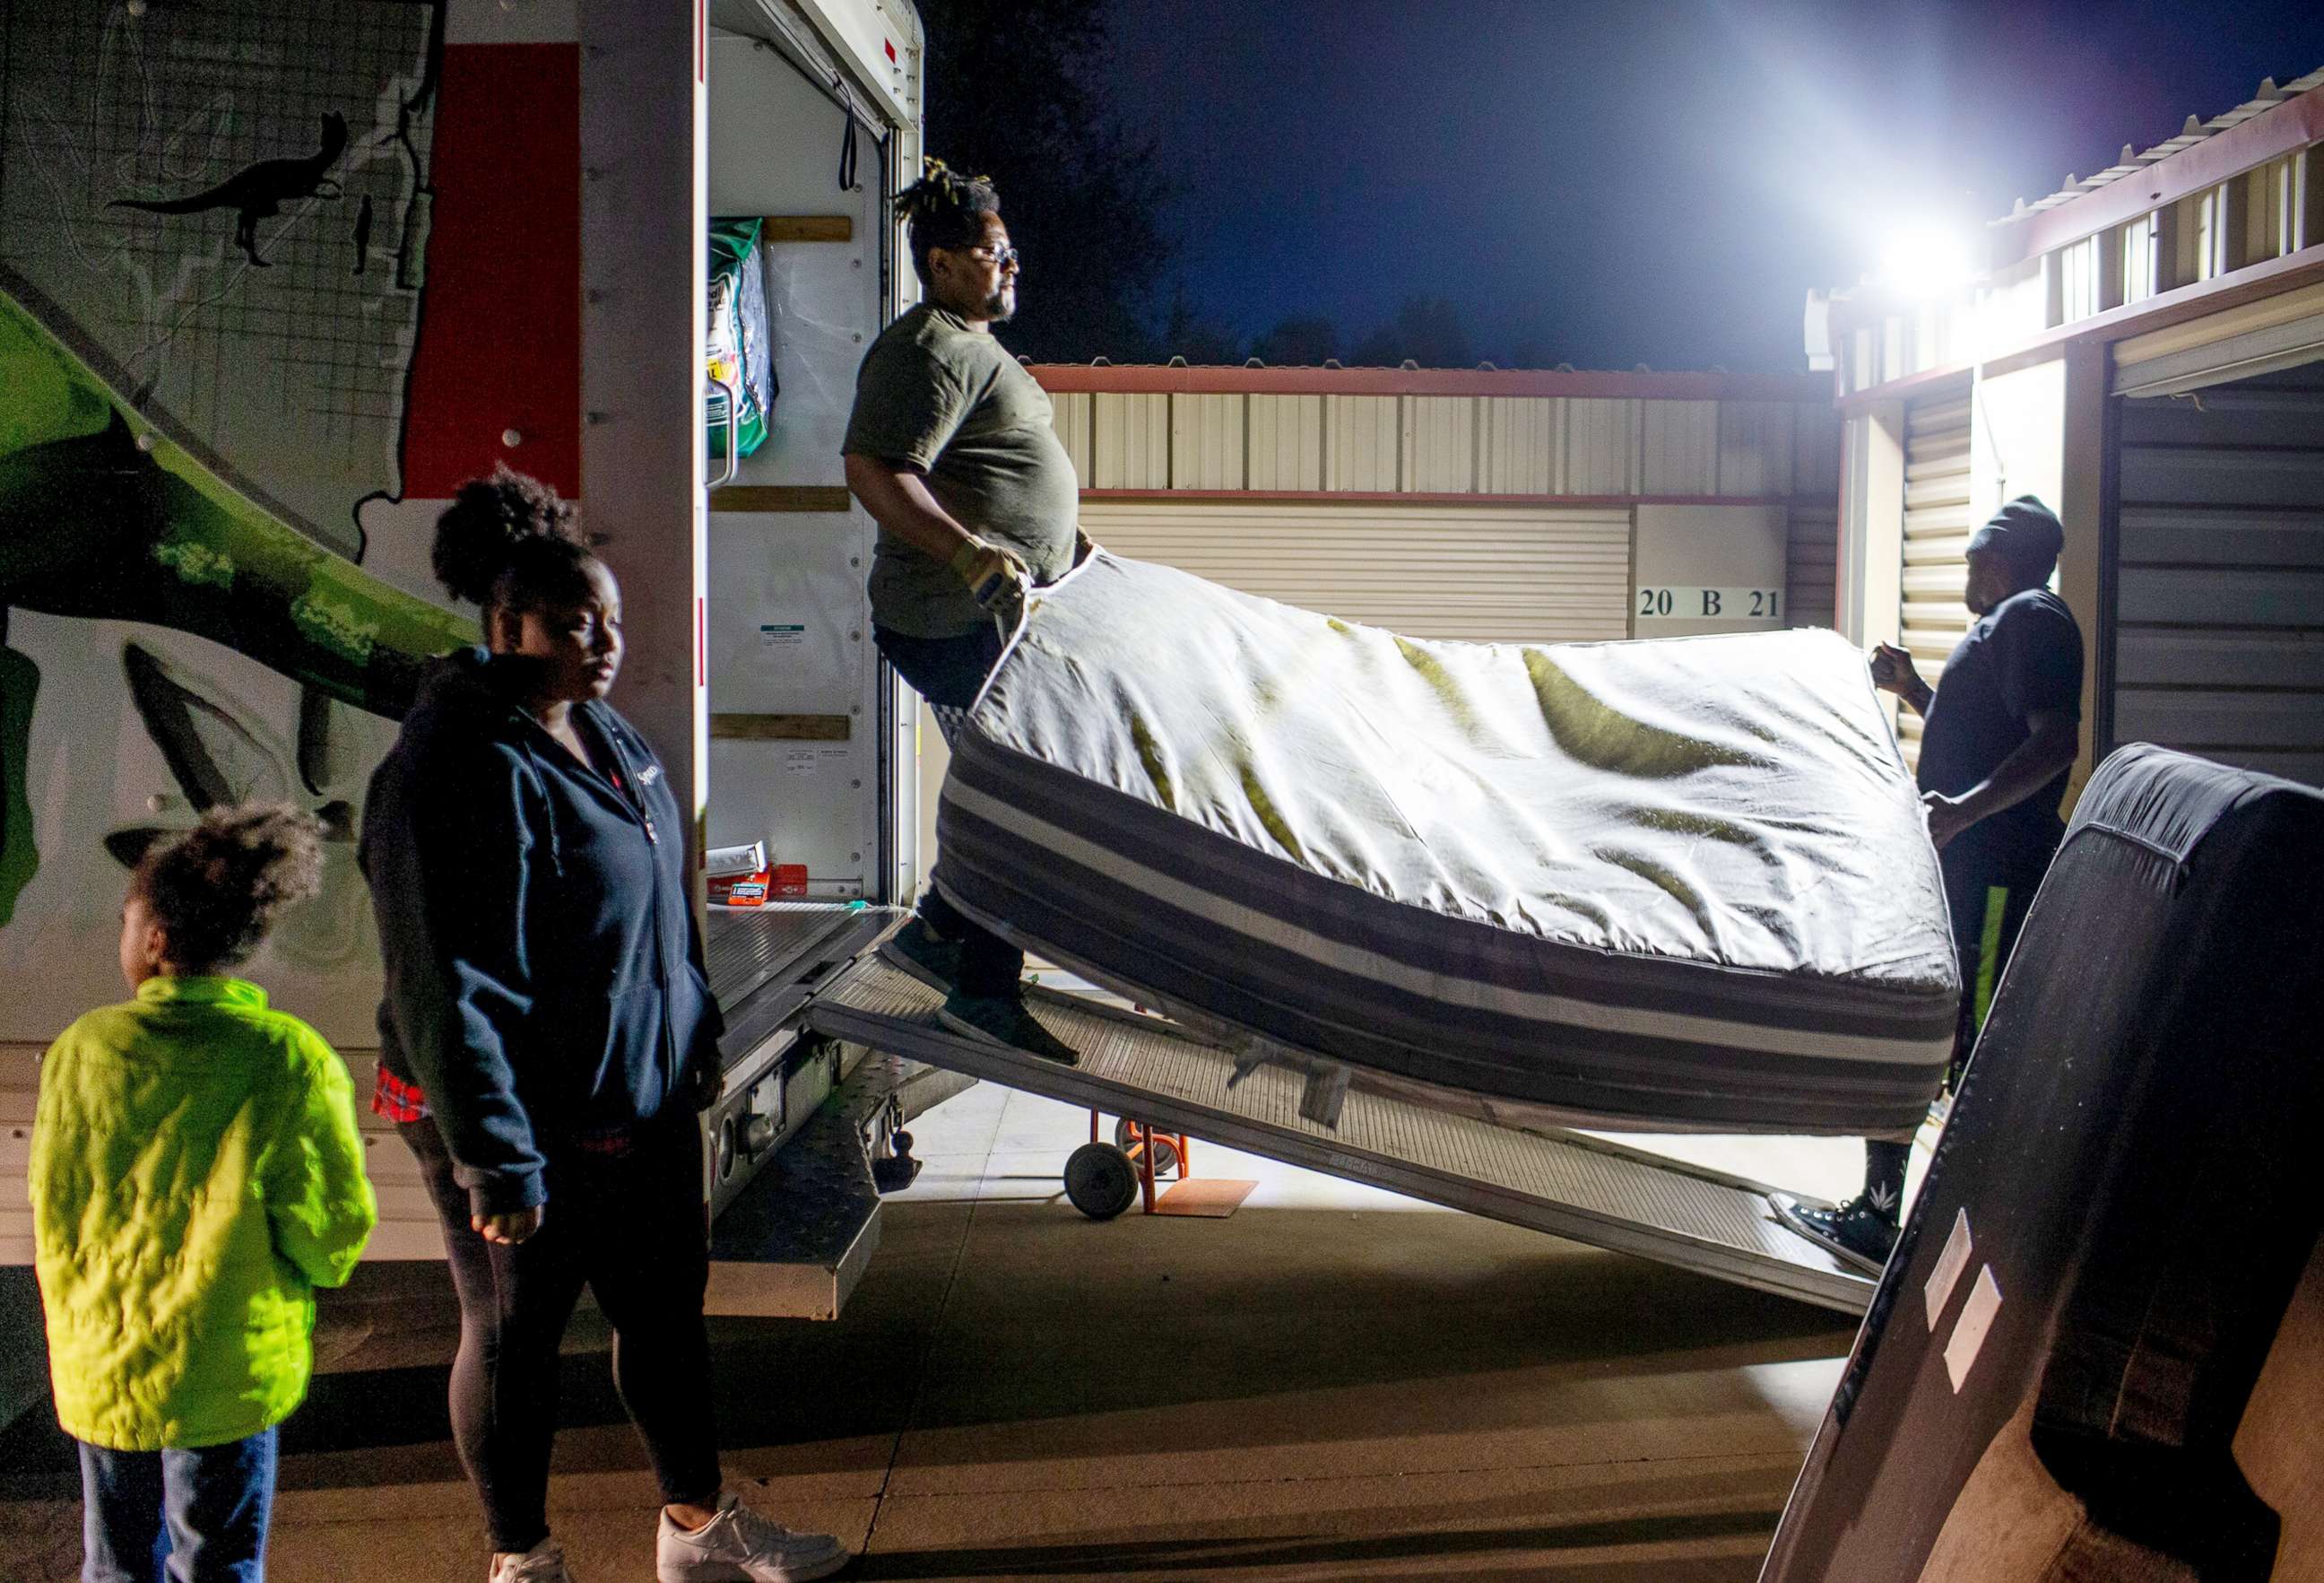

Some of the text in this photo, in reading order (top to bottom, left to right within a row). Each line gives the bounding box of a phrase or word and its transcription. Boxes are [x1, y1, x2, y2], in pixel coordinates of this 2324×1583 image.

[1639, 588, 1778, 617] 20 B 21
